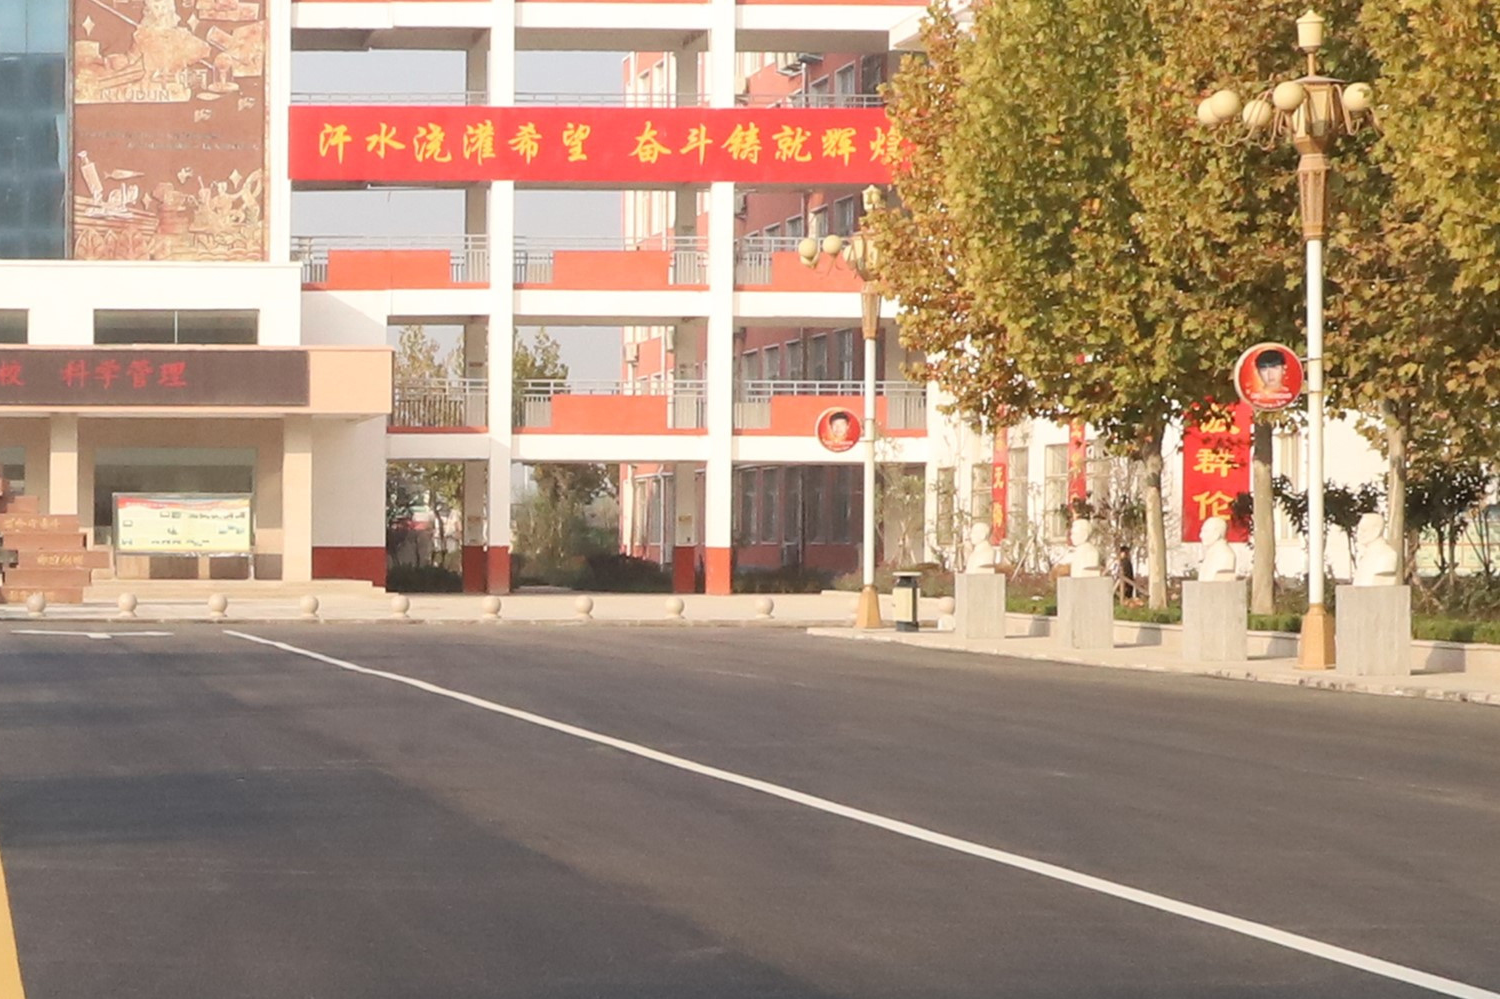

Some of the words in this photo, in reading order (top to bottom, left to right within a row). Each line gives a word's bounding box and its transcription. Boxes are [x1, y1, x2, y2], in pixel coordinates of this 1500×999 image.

[318, 120, 591, 165] 汗水浇灌希望
[62, 358, 187, 389] 科学管理
